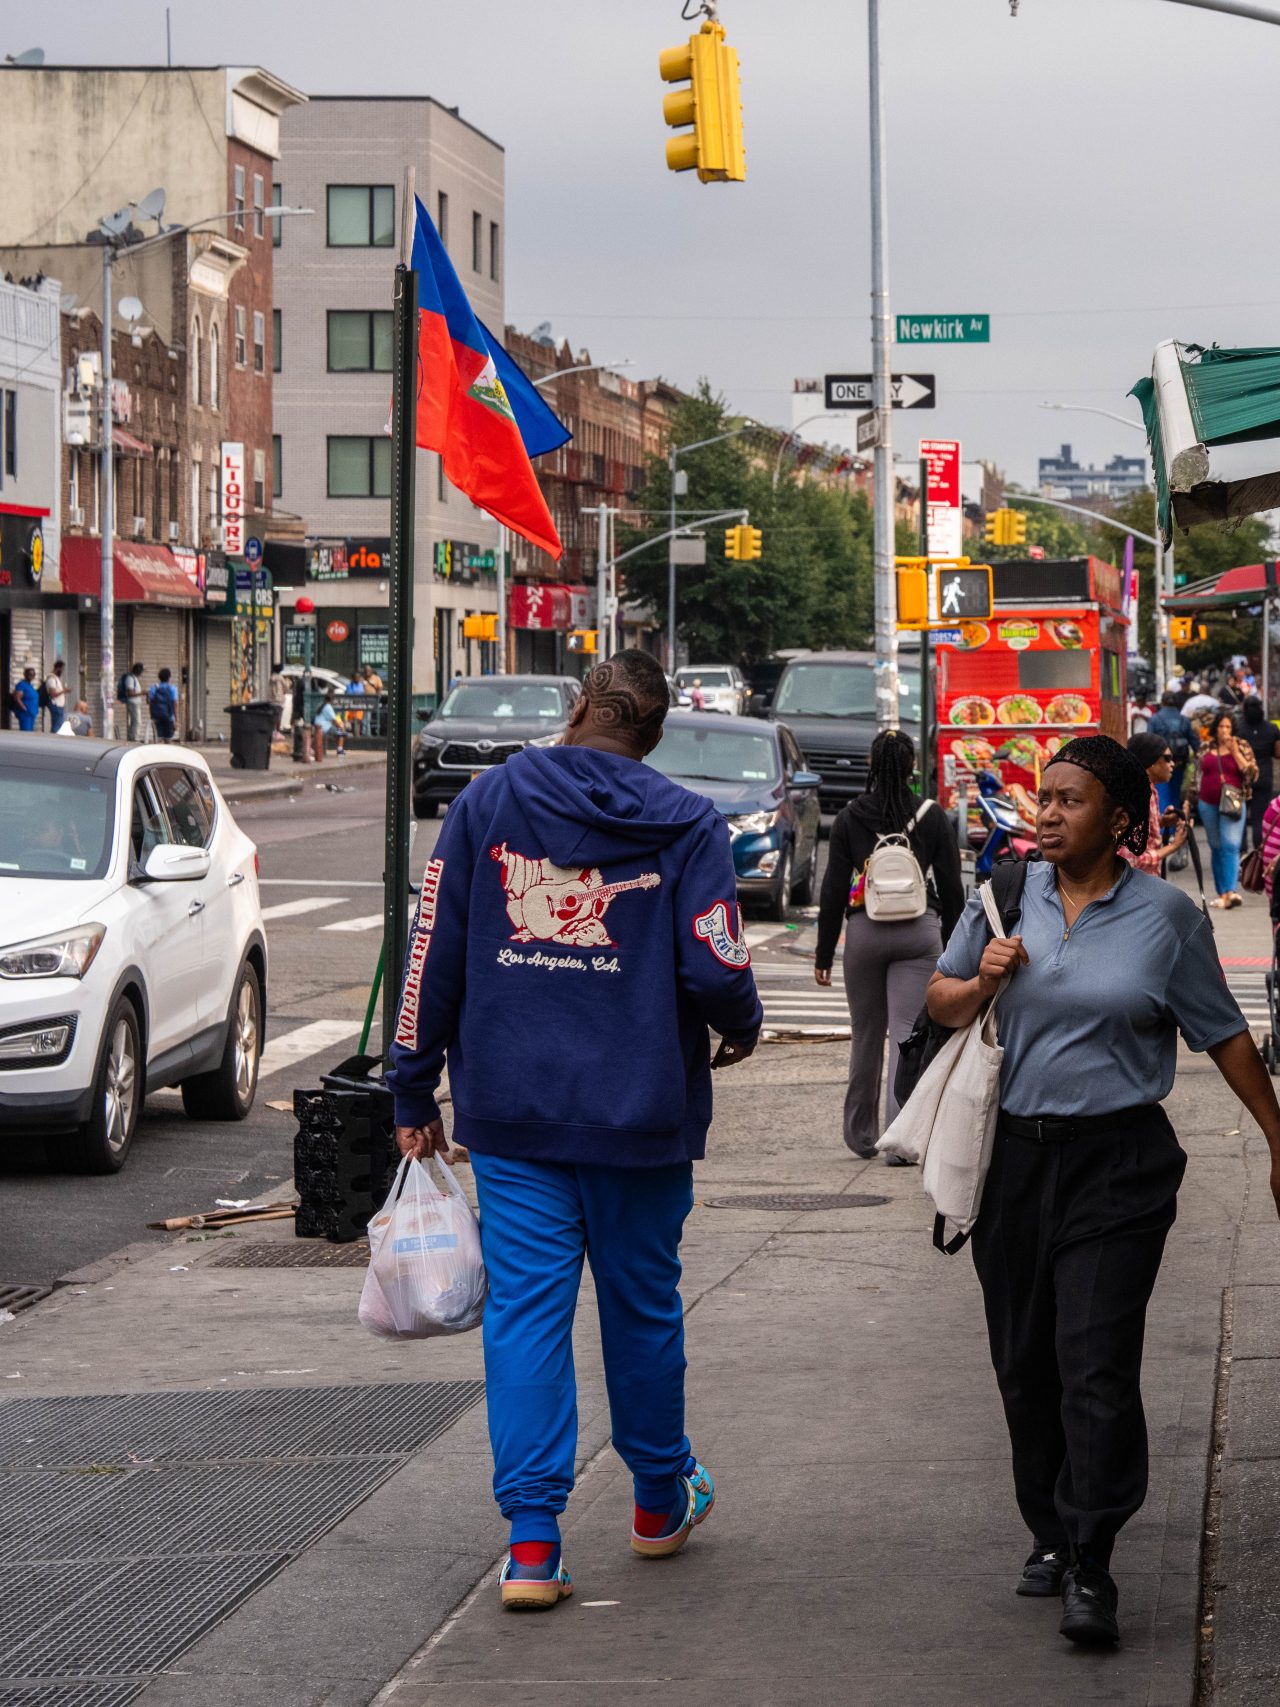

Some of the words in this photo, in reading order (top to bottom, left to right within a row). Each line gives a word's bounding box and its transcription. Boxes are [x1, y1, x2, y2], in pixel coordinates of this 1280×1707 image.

[900, 319, 964, 339] Newkirk
[970, 318, 983, 331] Av
[836, 385, 866, 399] ONE
[225, 456, 241, 552] LIQUORS
[350, 546, 381, 568] ria
[527, 586, 543, 629] NAILS
[418, 858, 444, 931] TRUE
[496, 948, 525, 966] Los
[526, 951, 587, 970] Angeles,
[592, 956, 621, 973] CA.
[395, 931, 431, 1051] RELIGION
